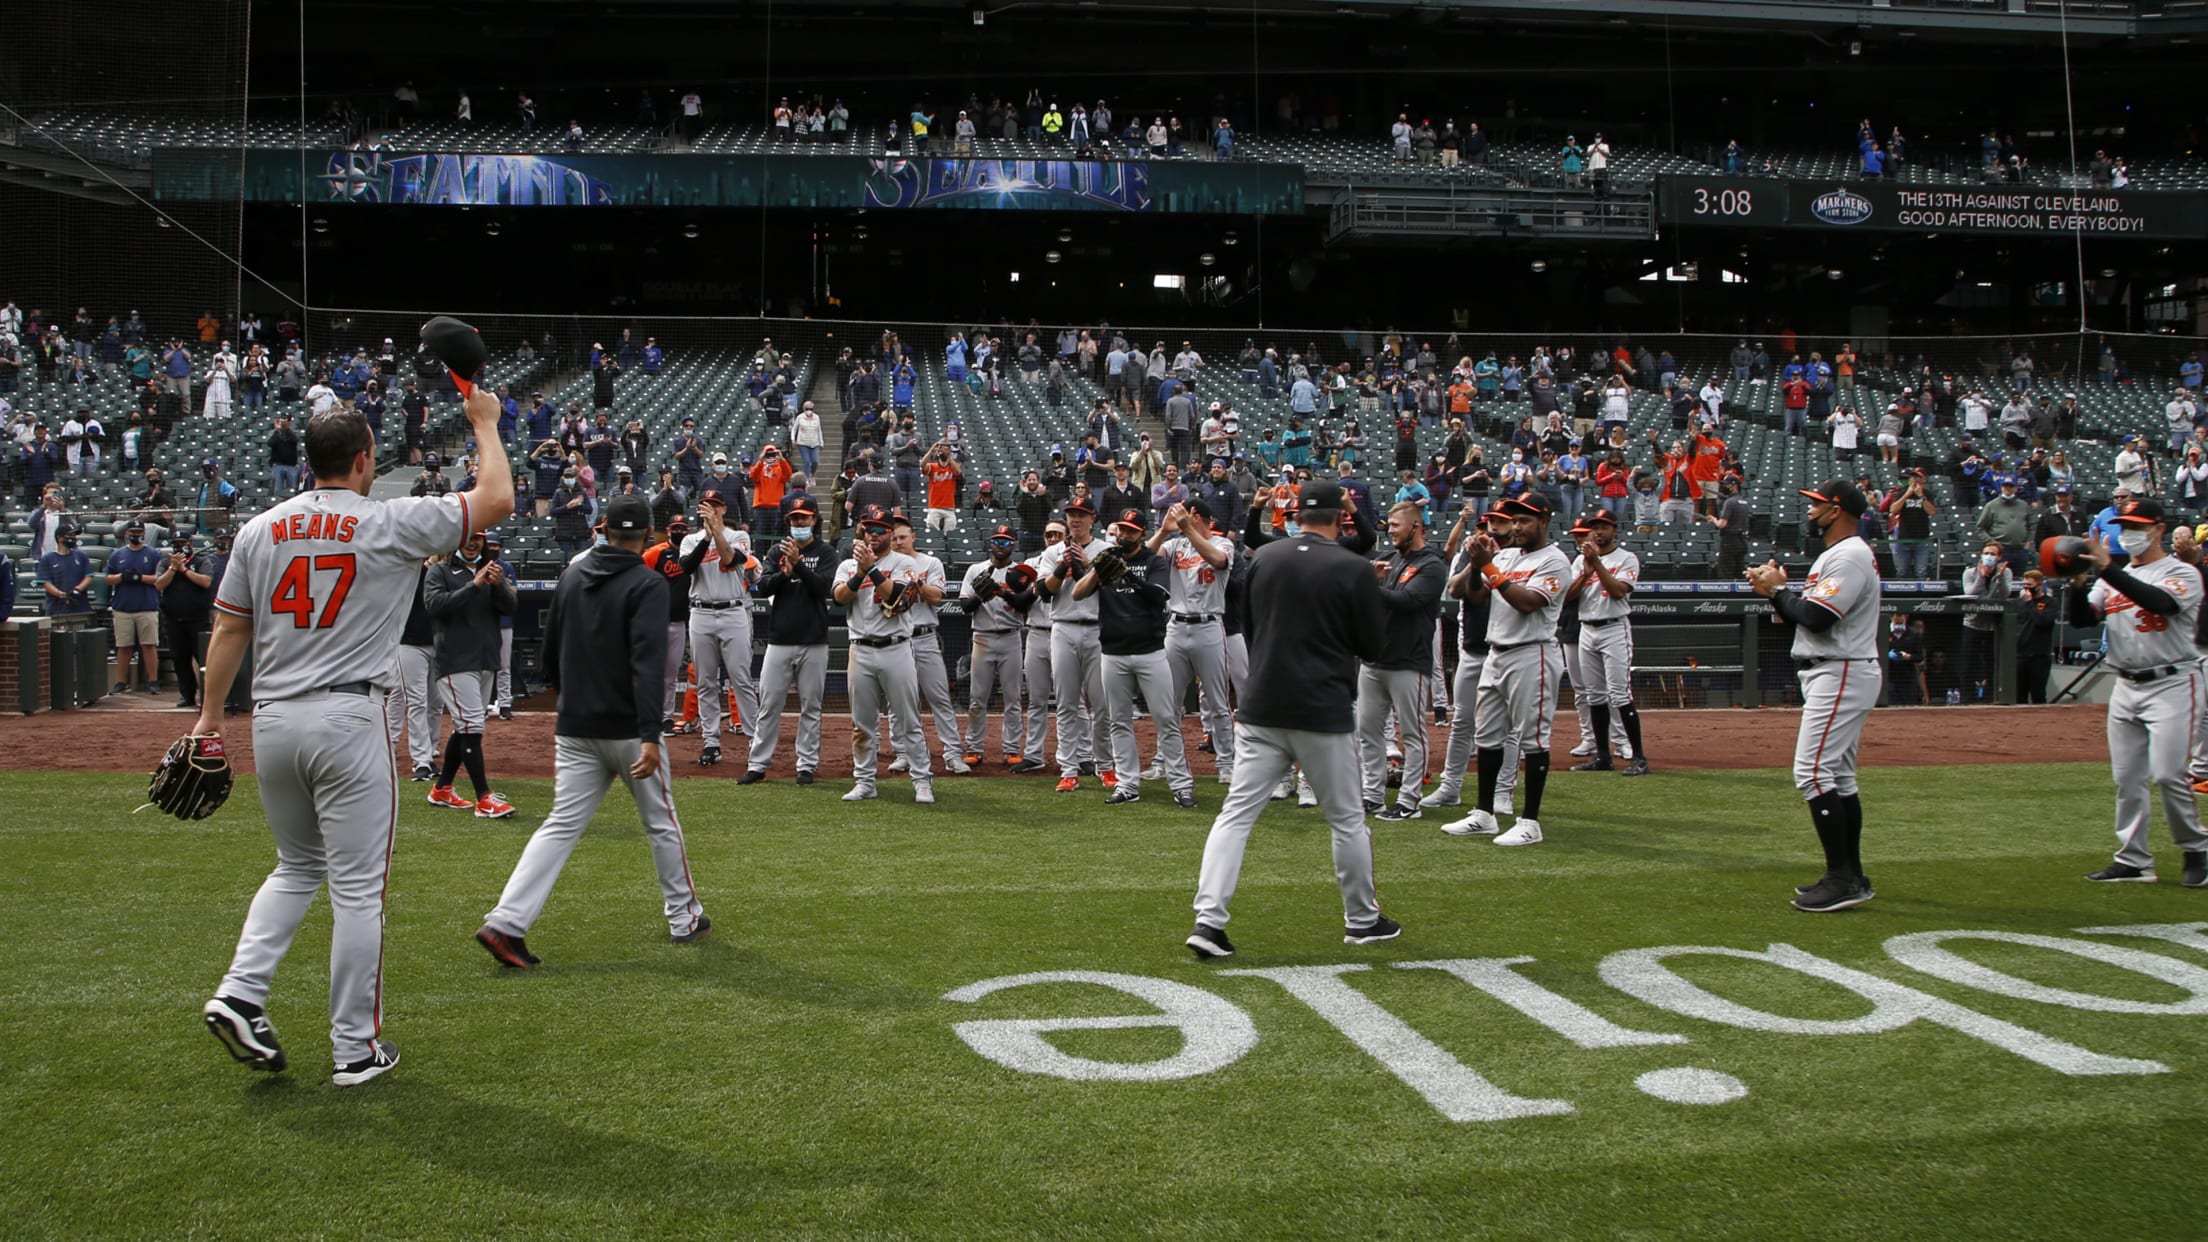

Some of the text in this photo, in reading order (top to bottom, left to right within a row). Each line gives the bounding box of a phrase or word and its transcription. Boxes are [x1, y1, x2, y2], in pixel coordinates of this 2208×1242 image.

[1693, 188, 1752, 216] 3:08
[1817, 196, 1869, 214] MARINERS
[1965, 193, 2030, 210] AGAINST
[2034, 196, 2124, 213] CLEVELAND.
[1897, 210, 2145, 233] GOOD AFTERNOON, EVERYBODY!
[271, 513, 359, 546] MEANS
[1197, 567, 1216, 585] 16
[270, 552, 357, 629] 47
[936, 601, 966, 615] Alas
[1631, 604, 1677, 614] #iFlyAlaska
[1693, 601, 1728, 613] Alaska
[1744, 604, 1776, 614] #iFlyAla
[1913, 601, 1946, 612] Alaska
[943, 922, 2208, 1123] obile
